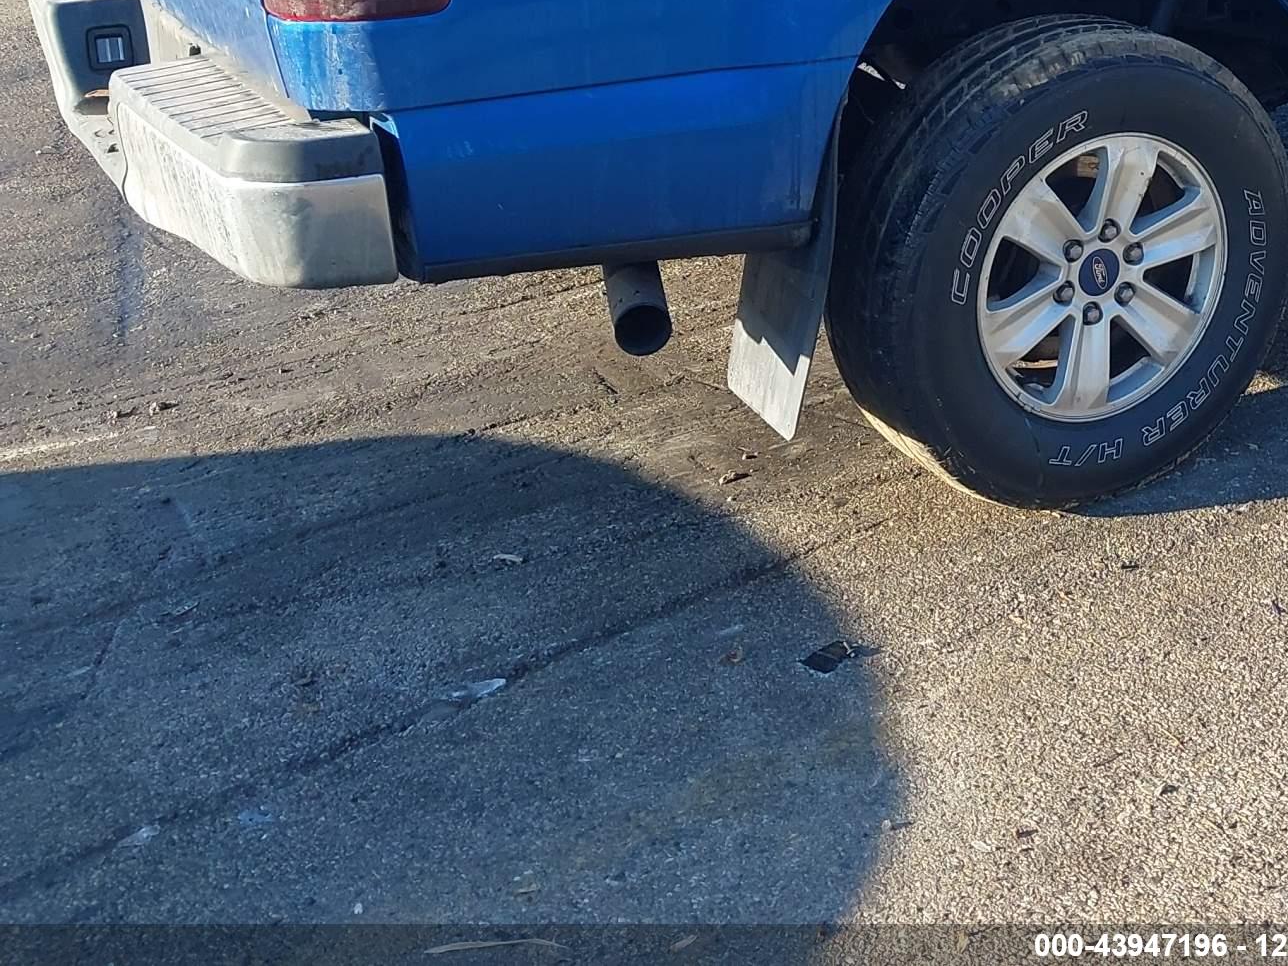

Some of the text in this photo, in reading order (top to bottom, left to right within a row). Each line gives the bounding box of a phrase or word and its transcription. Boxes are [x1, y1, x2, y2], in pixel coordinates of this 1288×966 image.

[951, 110, 1088, 305] COOPER
[1049, 189, 1267, 467] ADVENTURER H/T
